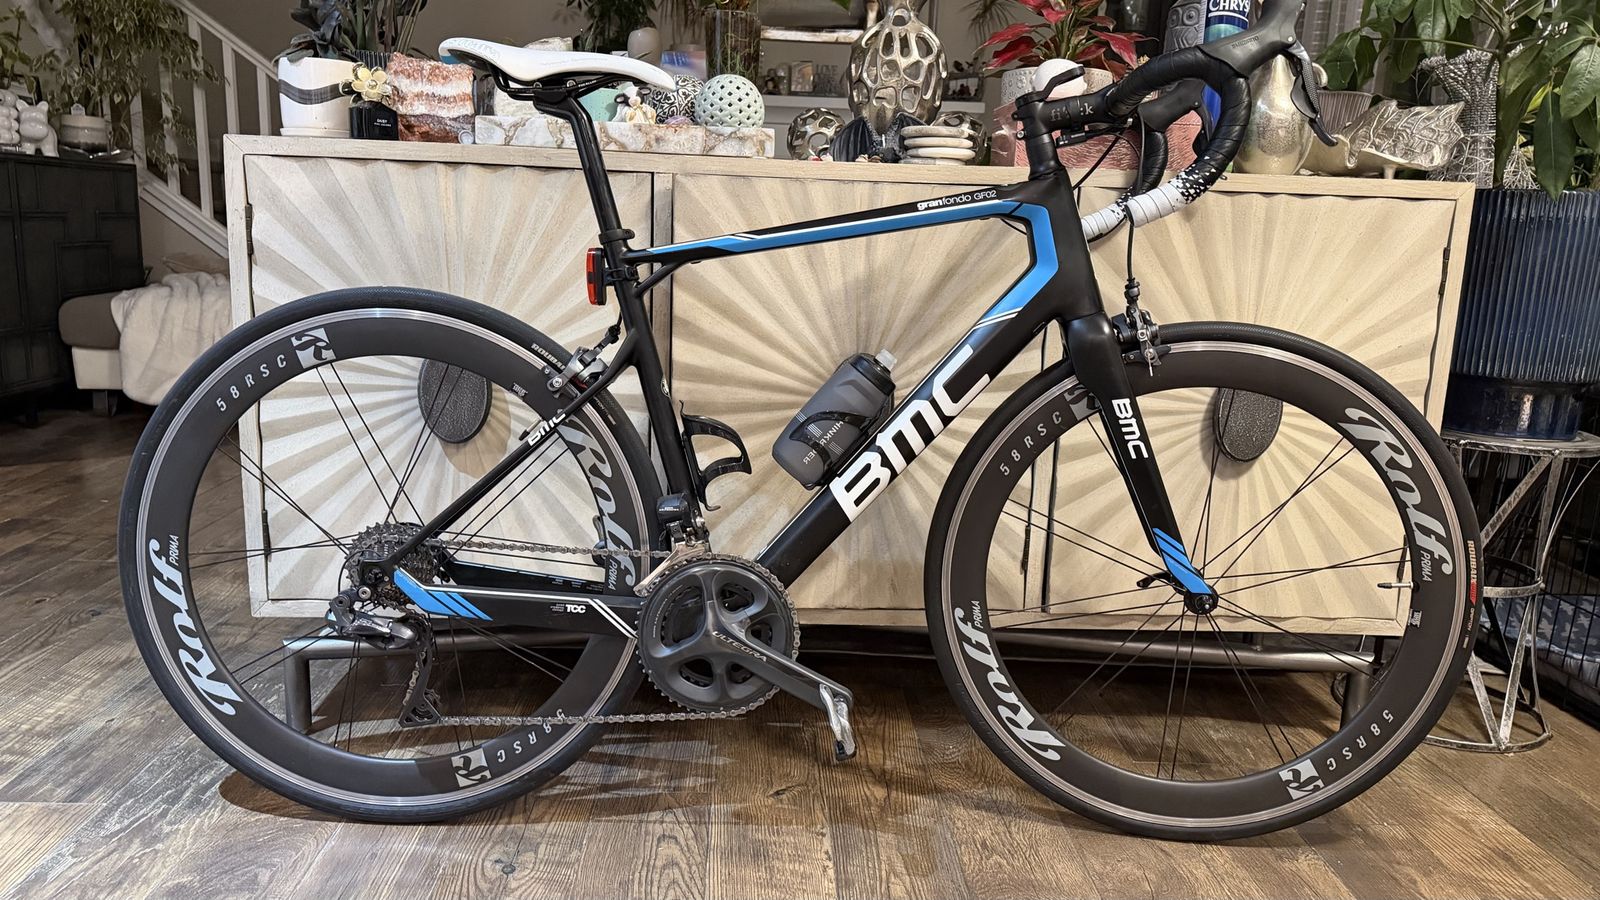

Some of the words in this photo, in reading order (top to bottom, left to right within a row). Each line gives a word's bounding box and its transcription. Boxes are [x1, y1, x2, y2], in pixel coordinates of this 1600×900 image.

[917, 194, 972, 210] granfondo
[973, 189, 997, 201] GF02
[829, 344, 990, 522] BMC
[1112, 398, 1149, 459] BMC
[1337, 407, 1453, 576] Rolf
[1420, 550, 1433, 582] PRIMA
[168, 534, 180, 566] PRIMA
[608, 559, 618, 591] PRIMA
[565, 603, 586, 614] TCC
[971, 600, 984, 629] PRIMA
[149, 539, 244, 716] Rolf
[712, 630, 767, 662] ULTEGRA
[954, 607, 1066, 761] Rolf
